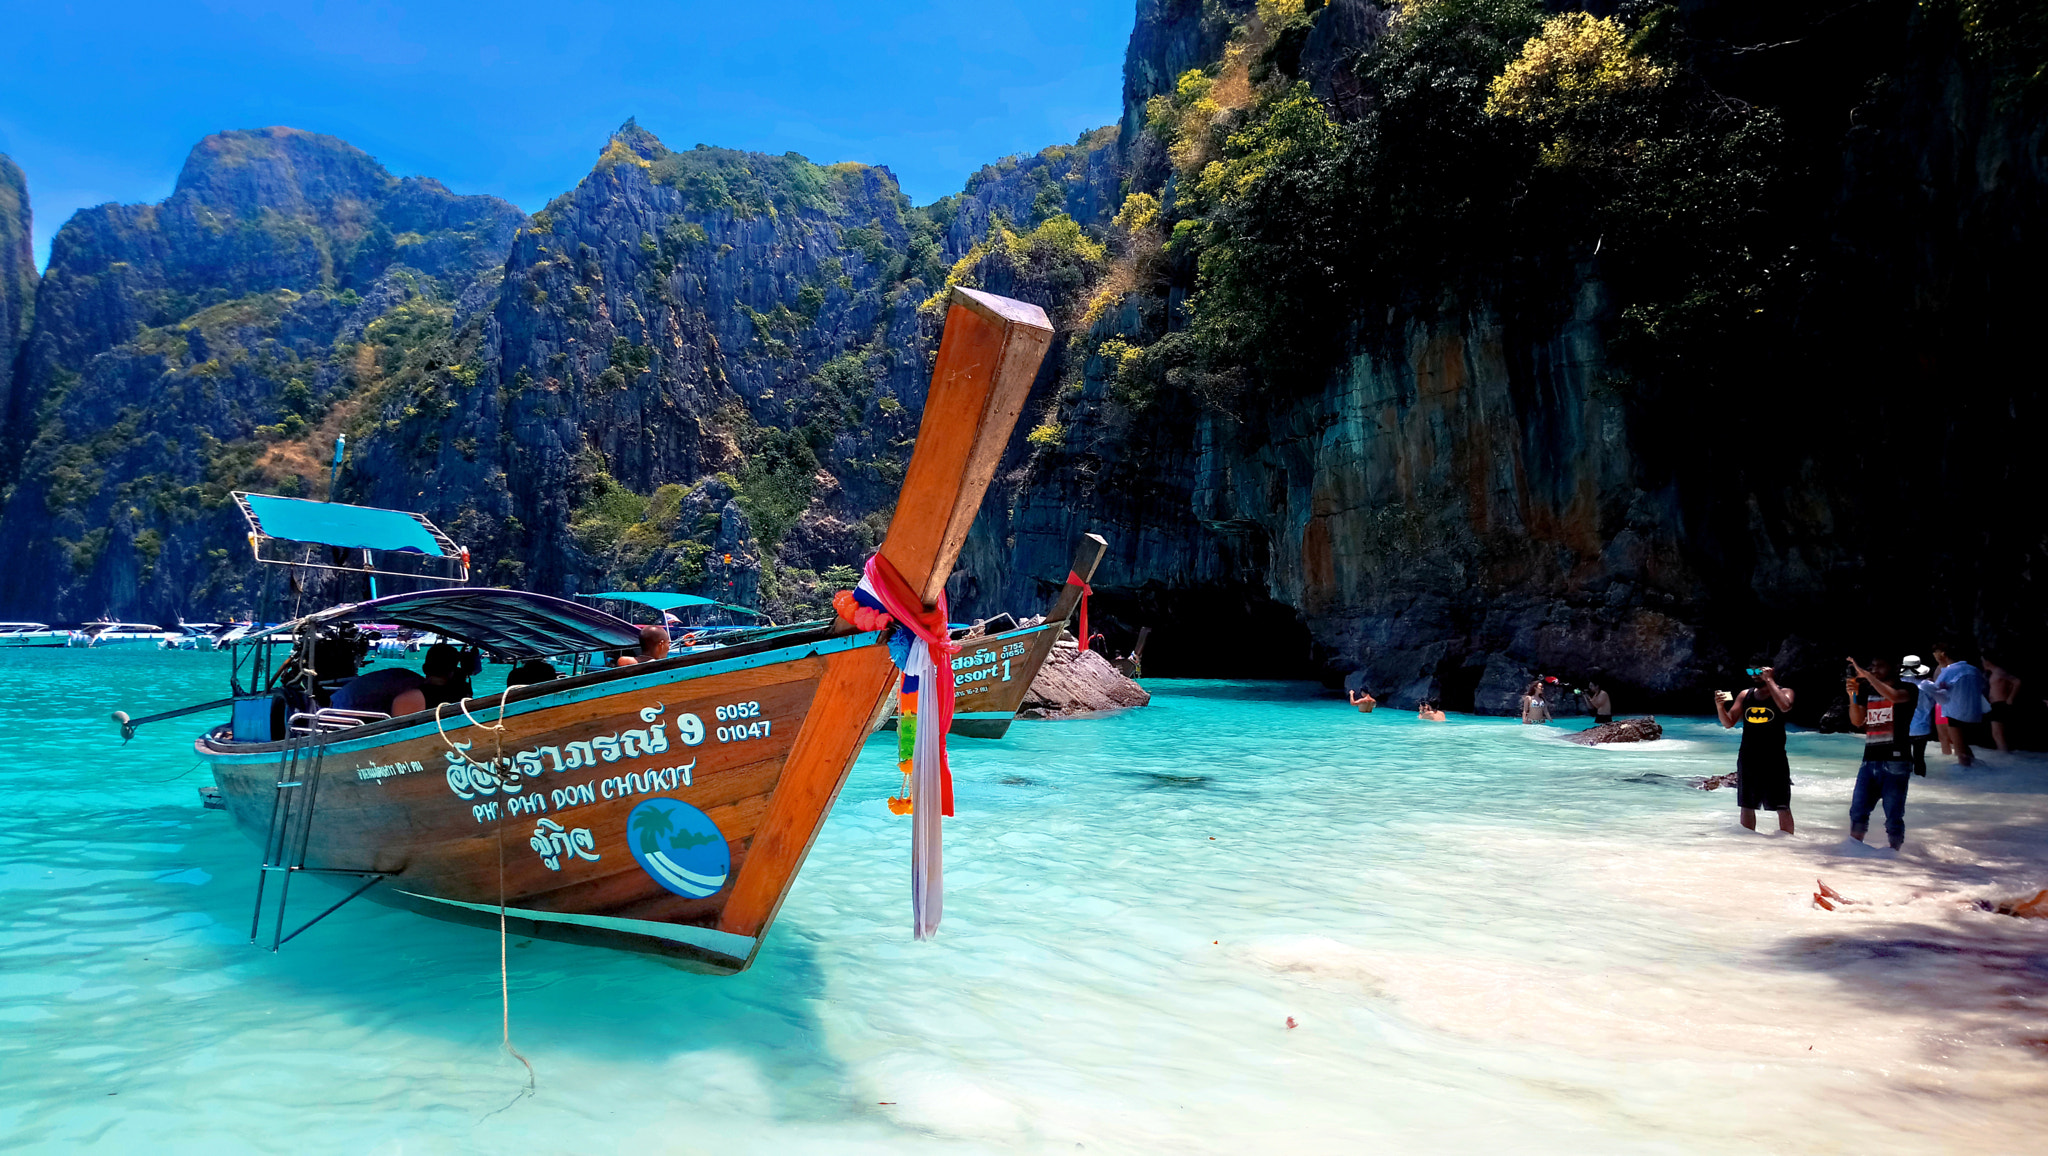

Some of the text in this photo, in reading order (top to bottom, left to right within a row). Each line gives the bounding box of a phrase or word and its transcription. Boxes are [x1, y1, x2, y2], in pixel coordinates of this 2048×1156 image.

[950, 648, 997, 671] สอร์ท
[1001, 659, 1012, 682] 1
[715, 701, 761, 722] 6052
[716, 720, 772, 744] 01047
[508, 792, 547, 817] PHI
[552, 780, 596, 811] DON
[601, 757, 696, 799] CHUKIT
